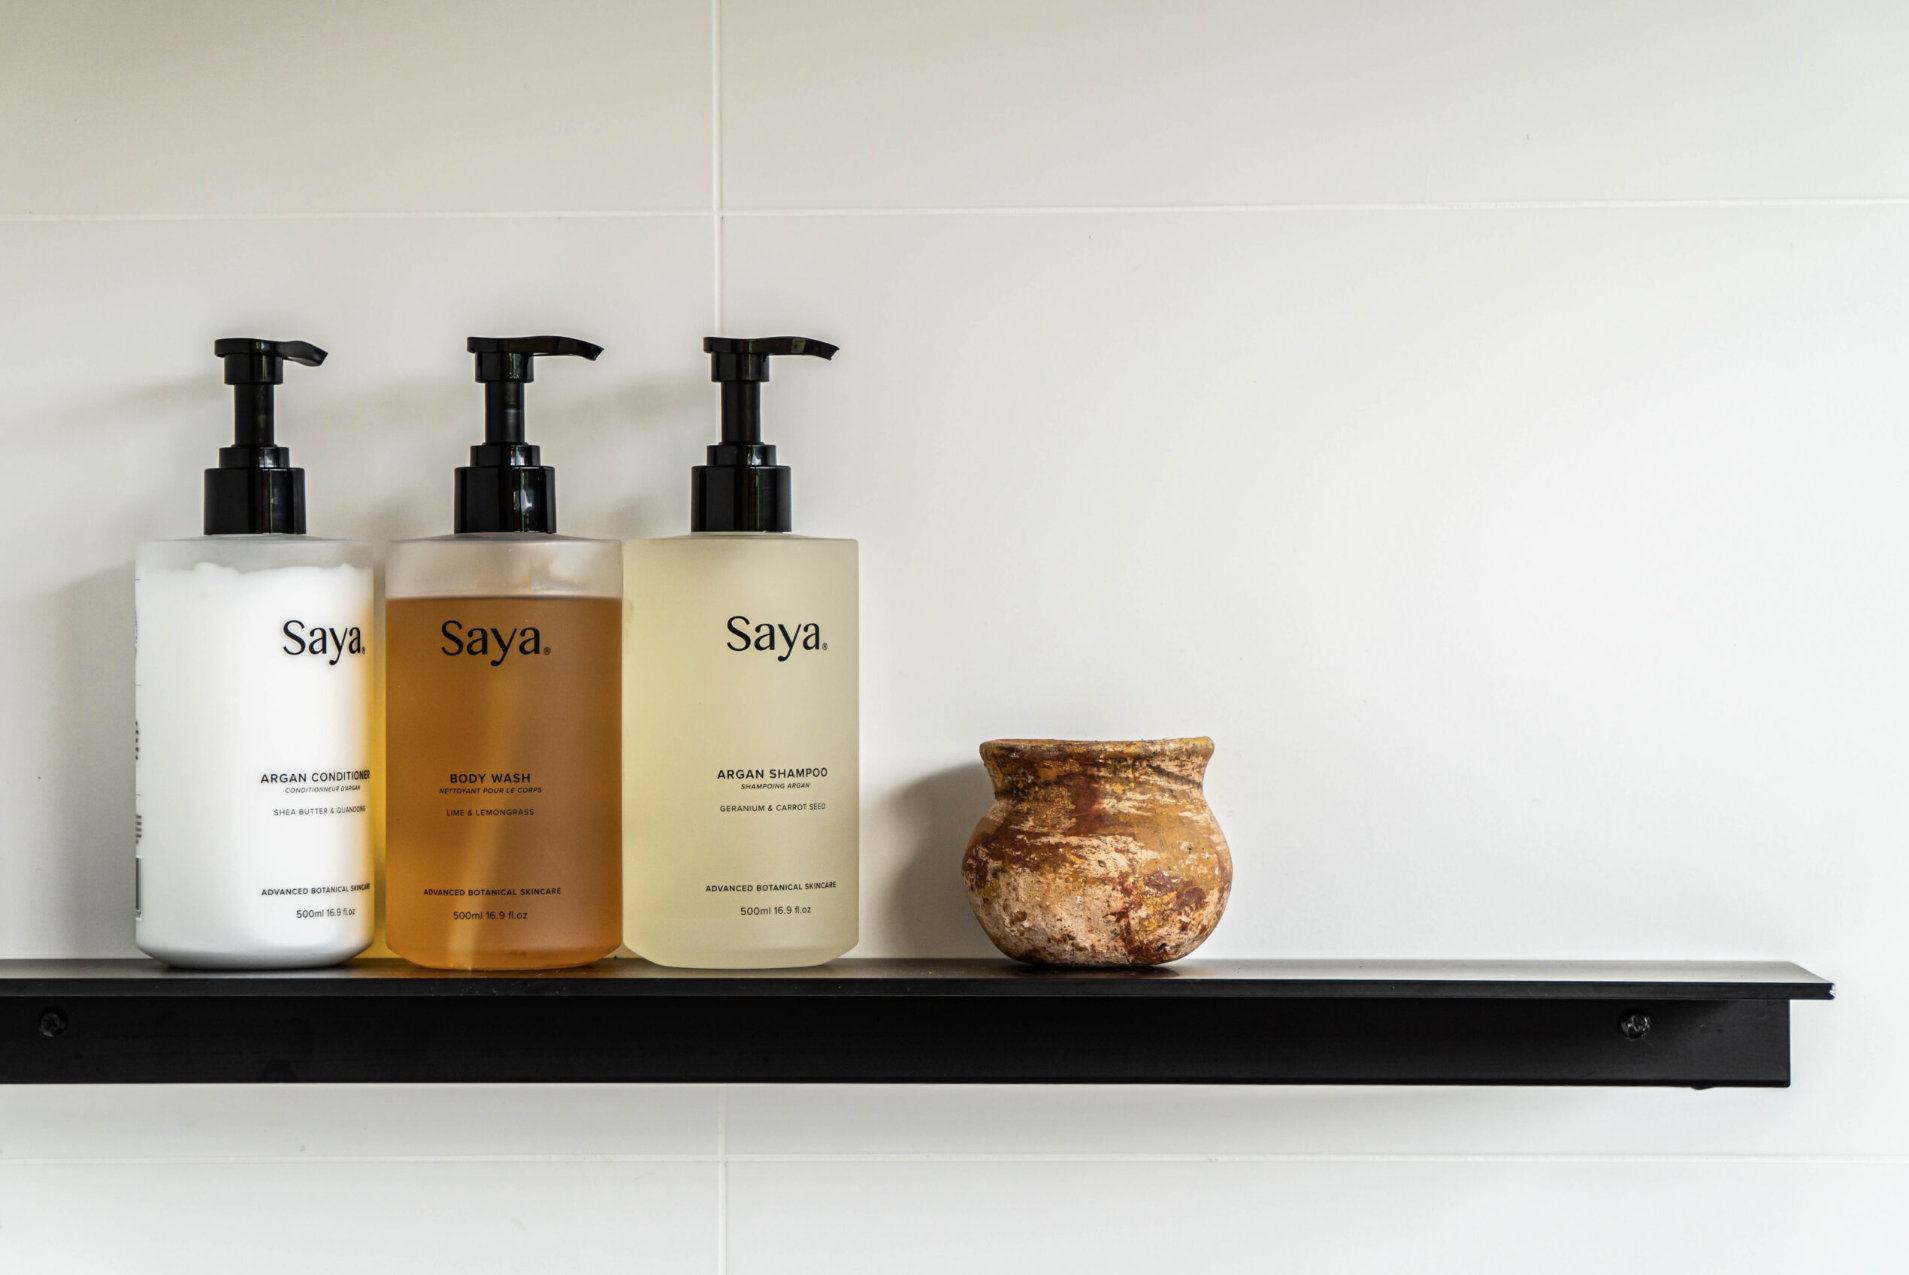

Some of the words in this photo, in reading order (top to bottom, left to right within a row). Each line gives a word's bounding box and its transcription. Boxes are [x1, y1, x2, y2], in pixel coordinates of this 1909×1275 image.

[260, 773, 307, 784] ARGAN
[311, 770, 370, 783] CONDITIONER
[450, 774, 487, 784] BODY
[491, 773, 531, 783] WASH
[717, 770, 765, 780] ARGAN
[769, 768, 828, 778] SHAMPOO
[285, 786, 339, 794] CONDITIONNEUR
[299, 808, 328, 816] BUTTER
[475, 809, 535, 817] LEMONGRASS
[261, 888, 309, 896] ADVANCED
[311, 886, 349, 895] BOTANICAL
[756, 884, 802, 892] BOTANICAL
[805, 881, 836, 890] SKINCARE
[520, 888, 561, 896] SKINCARE
[296, 909, 324, 918] 500ml
[326, 908, 342, 917] 16.9
[453, 911, 482, 920] 500ml
[486, 911, 505, 920] 16.9
[508, 911, 528, 919] fl.oz
[740, 906, 771, 916] 500ml
[774, 905, 792, 915] 16.9
[794, 905, 811, 914] fl.oz
